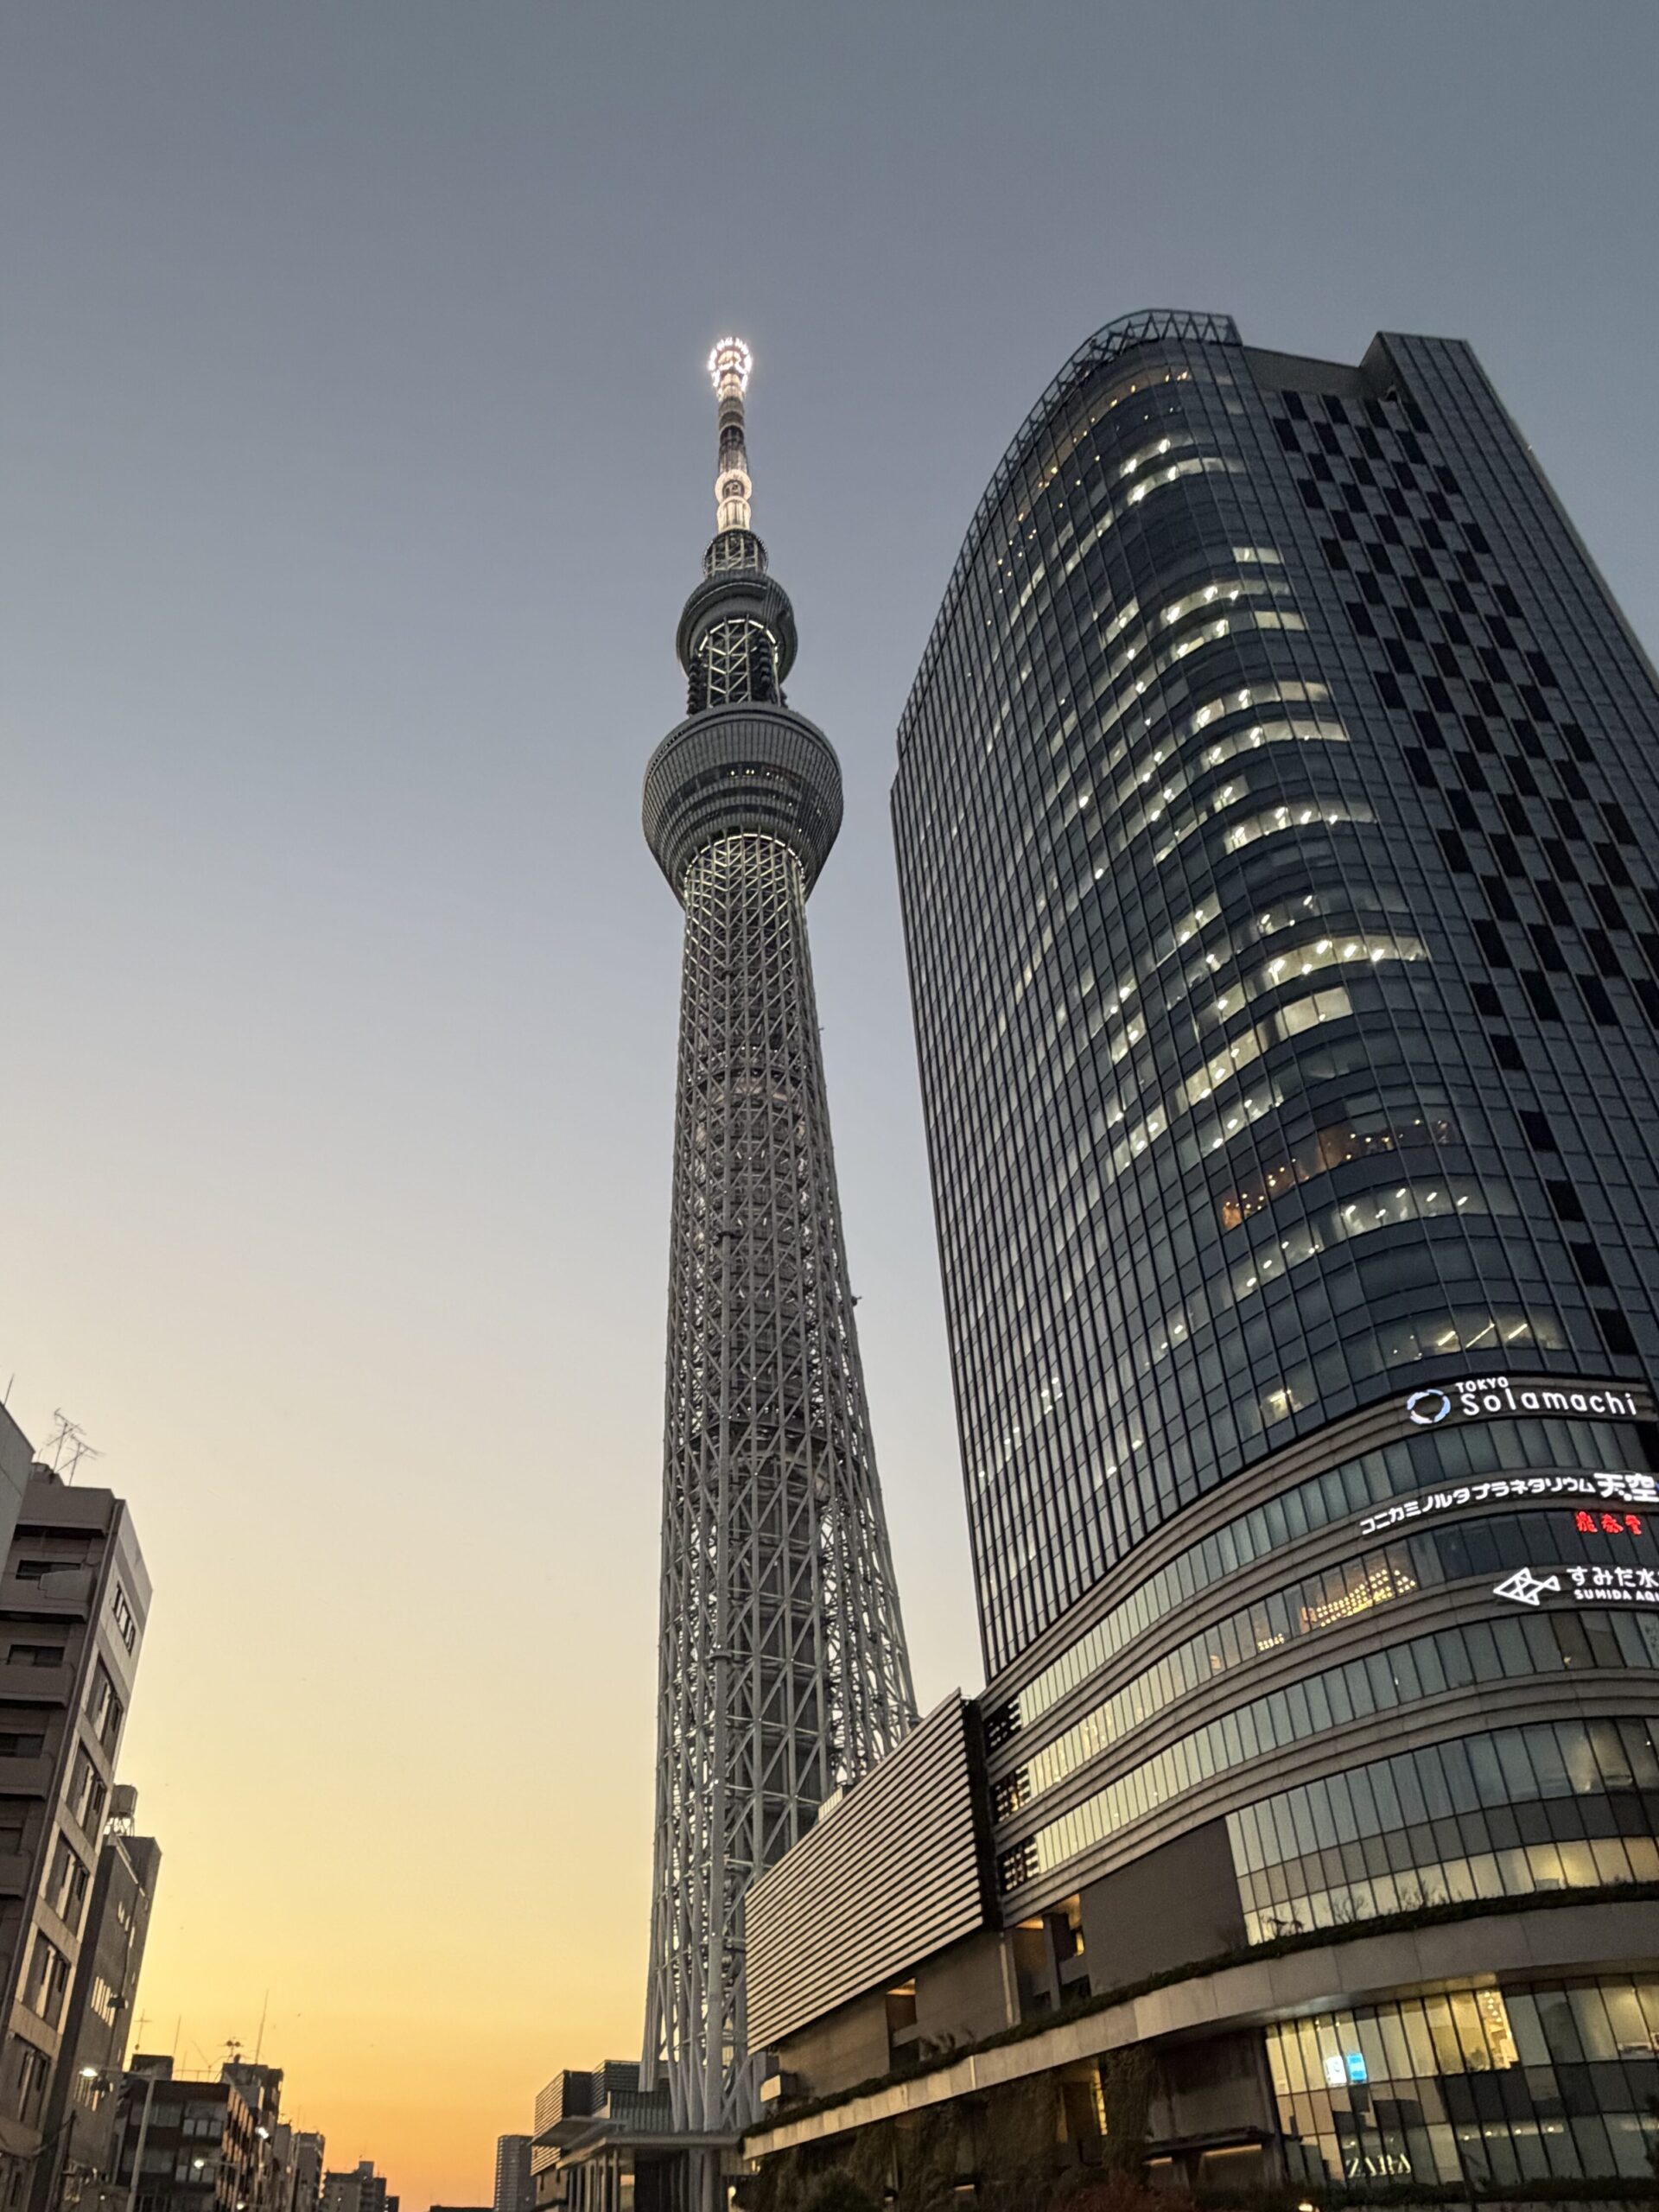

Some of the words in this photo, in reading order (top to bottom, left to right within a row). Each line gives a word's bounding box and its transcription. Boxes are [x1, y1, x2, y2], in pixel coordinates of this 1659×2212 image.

[1455, 1376, 1509, 1394] TOKYO
[1460, 1388, 1637, 1416] Solamachi
[1566, 1566, 1659, 1588] すみだ水
[1573, 1589, 1632, 1601] SUMIDA
[1345, 2152, 1412, 2178] ZARA
